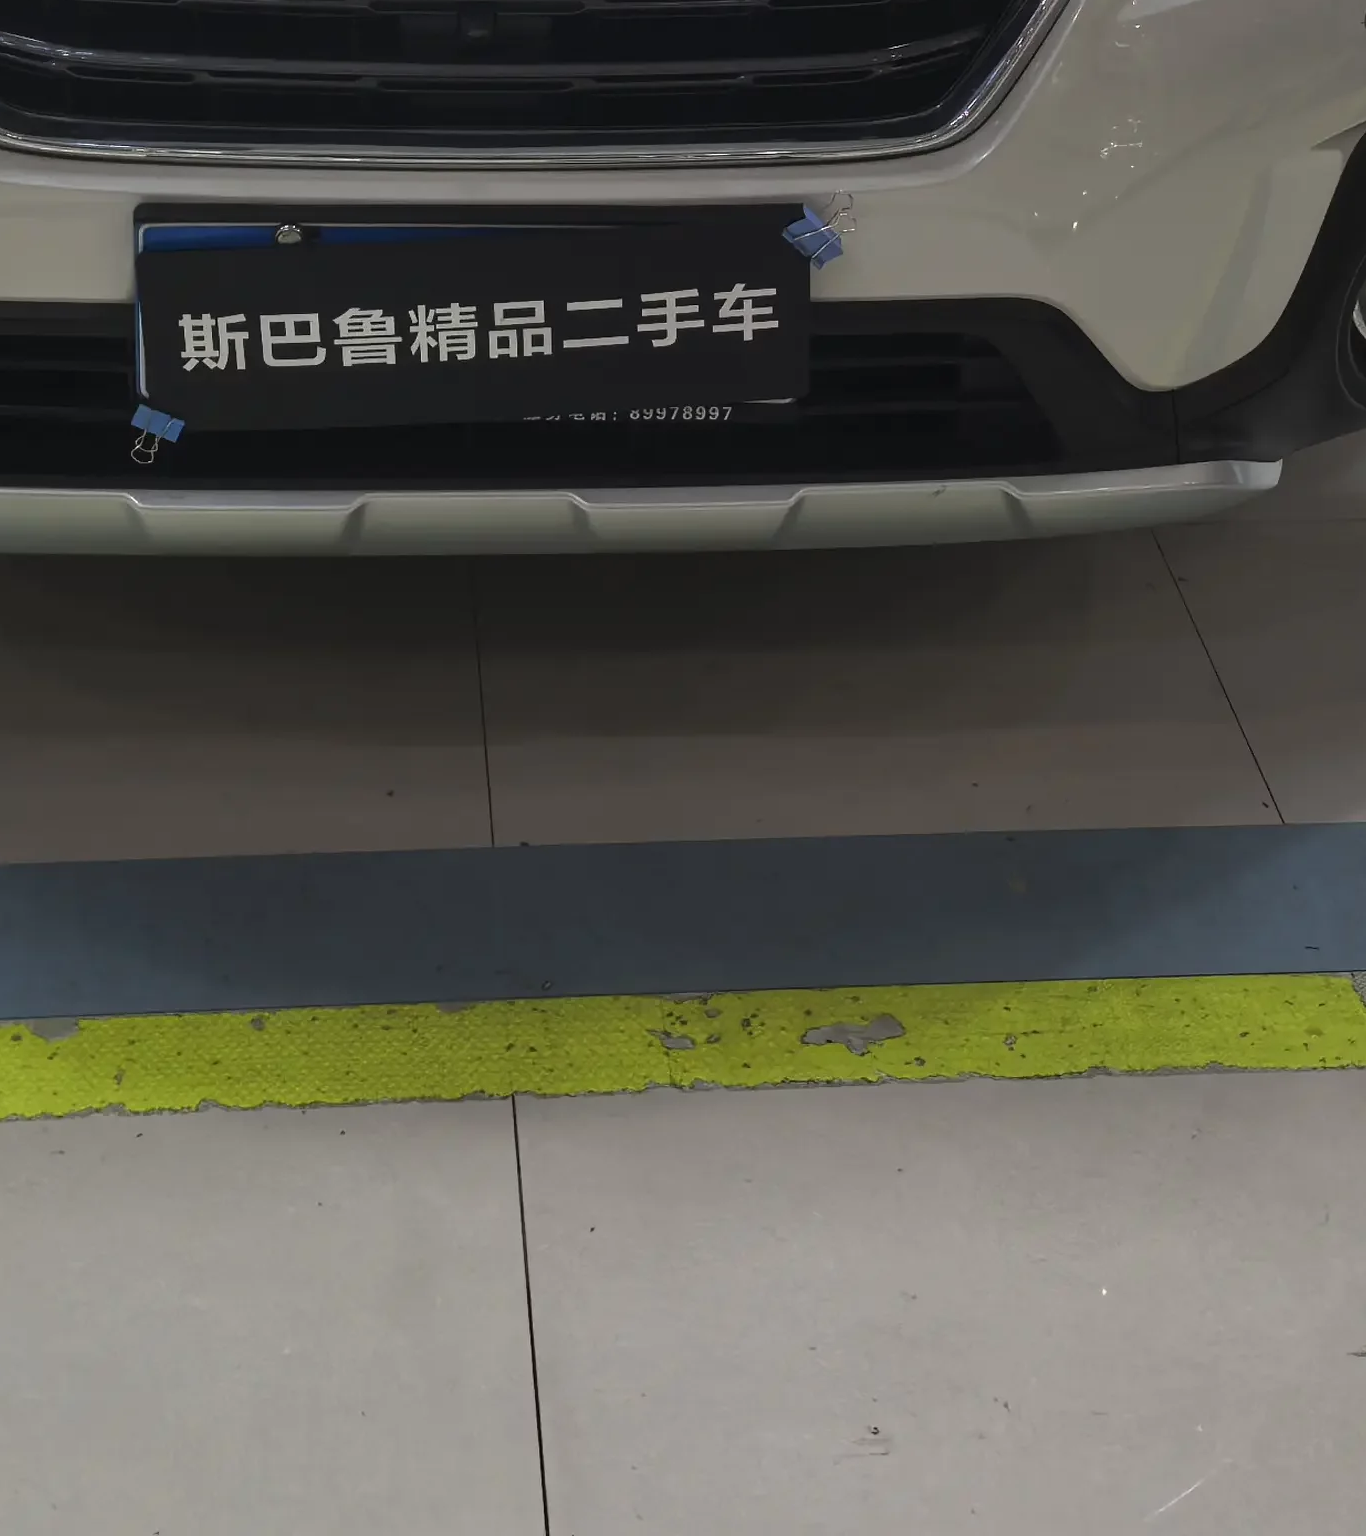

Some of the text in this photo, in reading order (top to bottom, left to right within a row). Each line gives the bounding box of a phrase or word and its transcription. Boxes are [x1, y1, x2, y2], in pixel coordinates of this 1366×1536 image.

[178, 283, 780, 372] 斯巴鲁精品二手车
